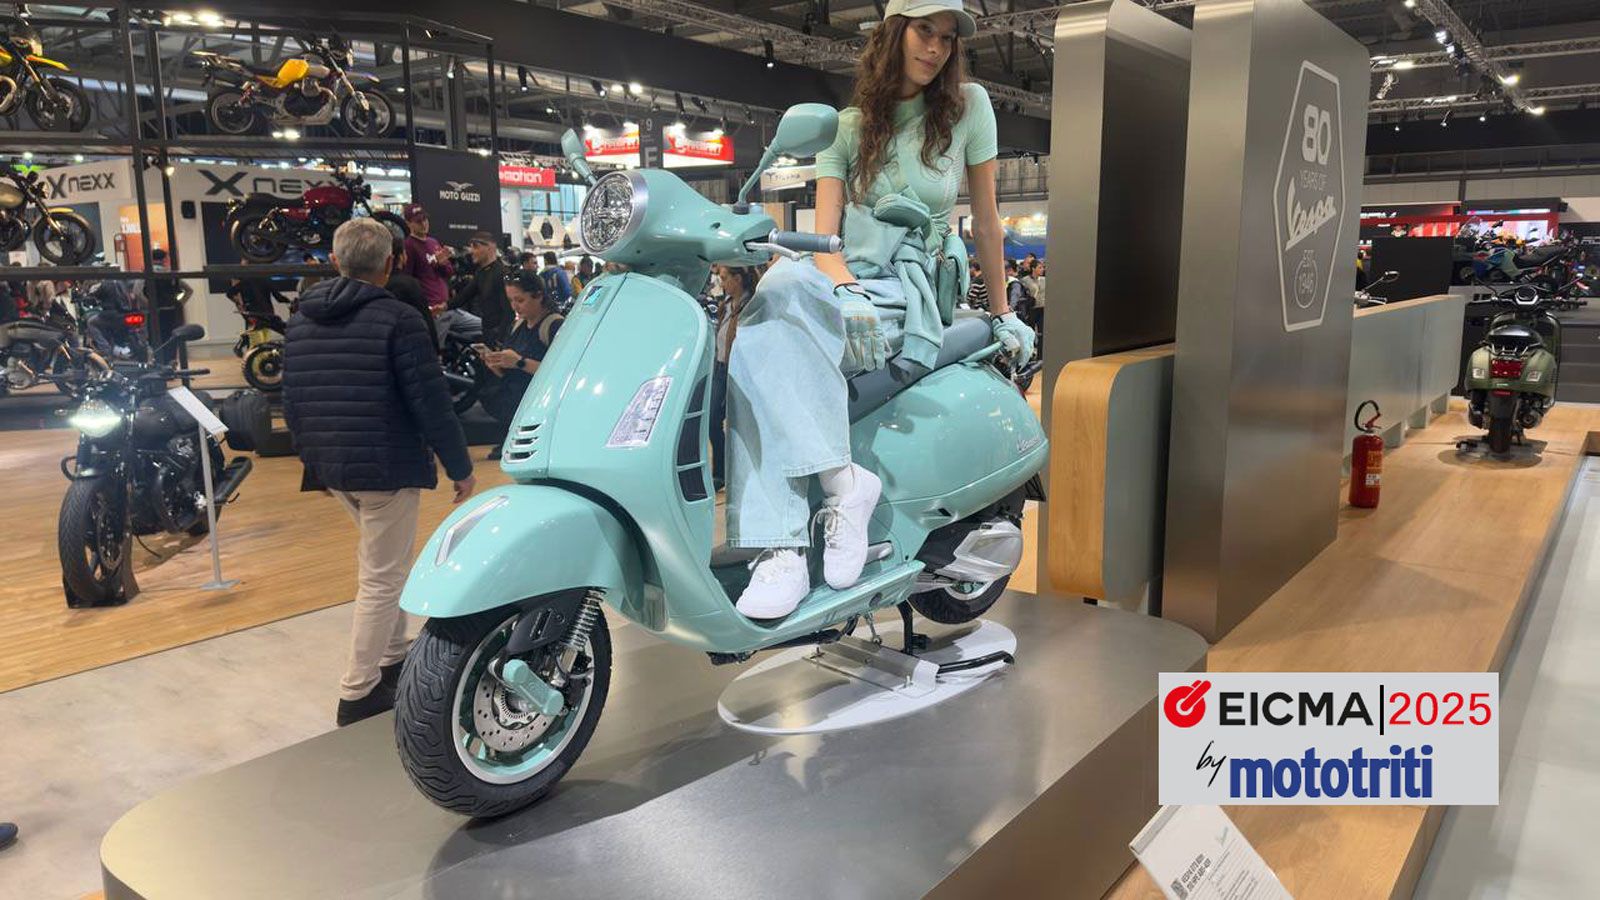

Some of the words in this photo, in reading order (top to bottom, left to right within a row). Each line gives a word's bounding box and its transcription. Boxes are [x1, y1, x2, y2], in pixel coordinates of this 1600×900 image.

[1302, 104, 1331, 165] 80
[440, 190, 459, 200] MOTO
[460, 191, 480, 202] GUZZI
[1285, 177, 1336, 250] Vespa
